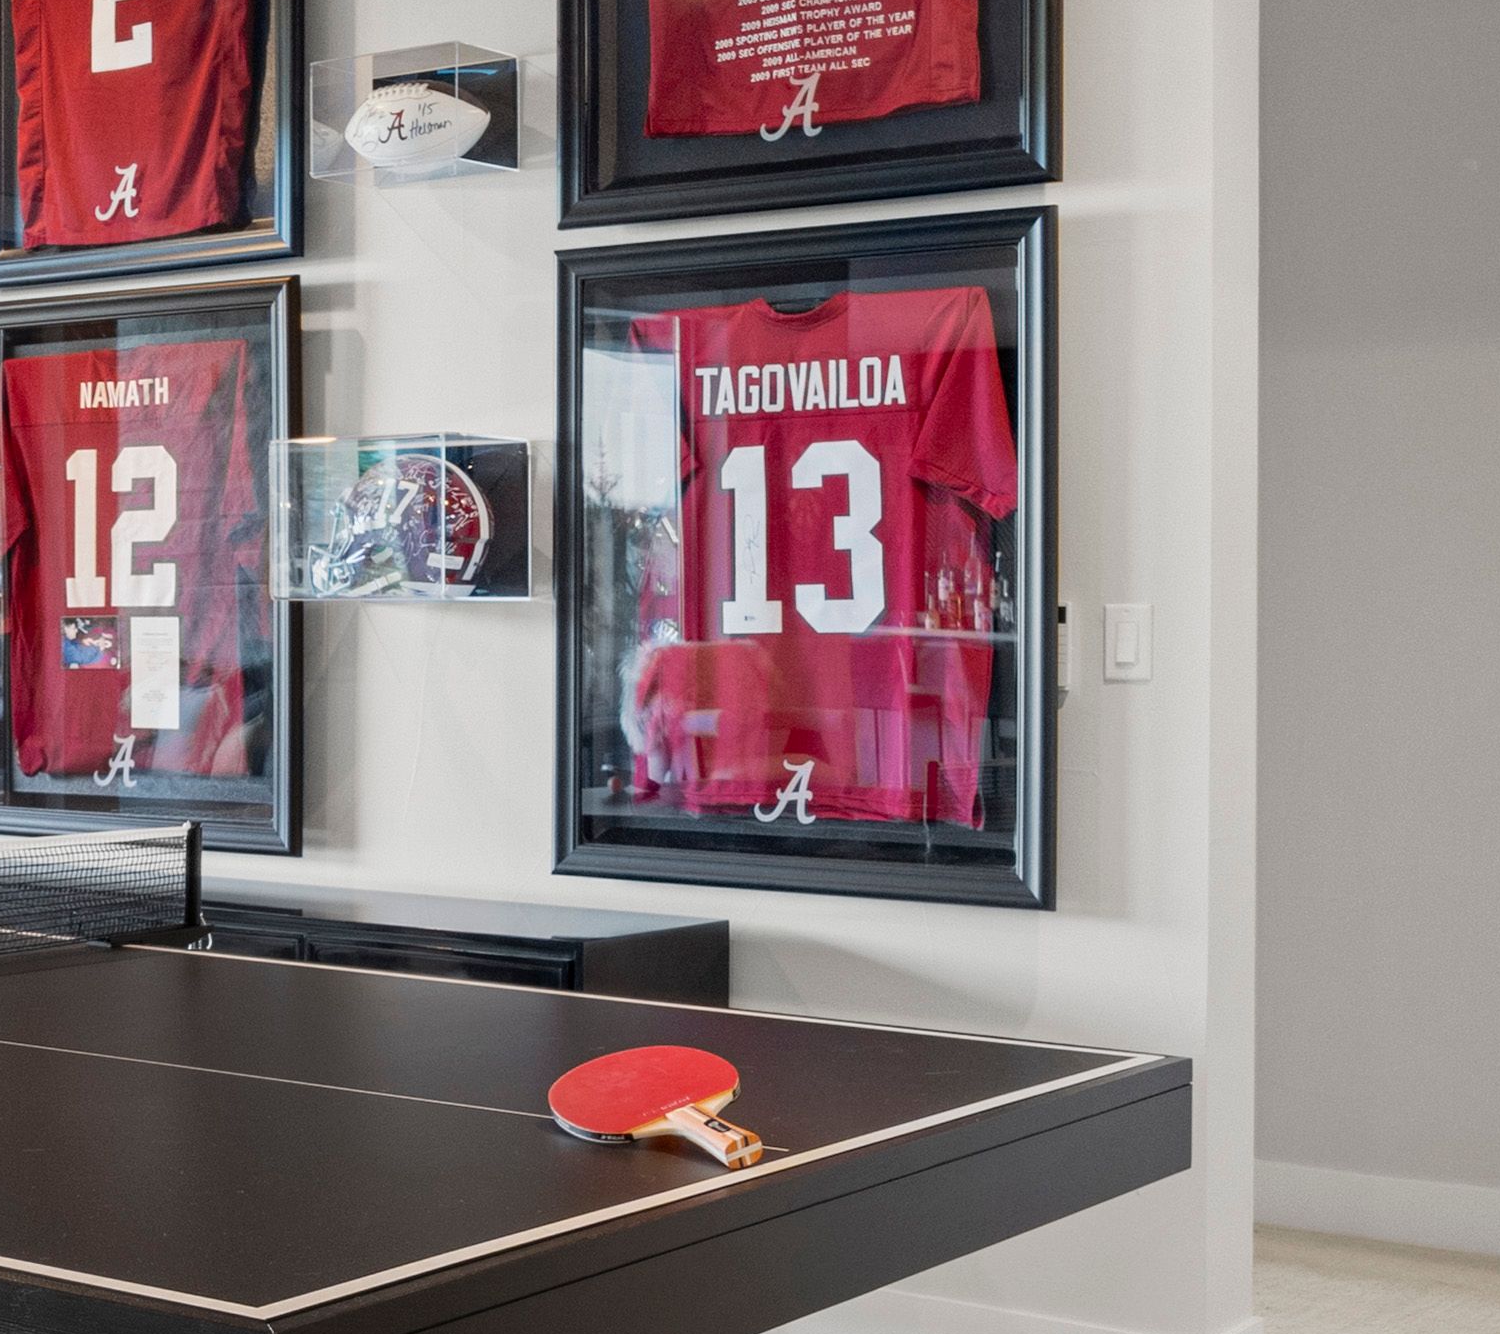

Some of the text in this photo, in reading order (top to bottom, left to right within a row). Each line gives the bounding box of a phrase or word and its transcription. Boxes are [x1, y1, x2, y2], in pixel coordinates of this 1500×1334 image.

[741, 2, 882, 32] 2009 HEISMAN TROPHY AWARD
[761, 3, 779, 15] 2009
[781, 0, 796, 11] SEC
[715, 10, 915, 50] 2009 SPORTING NEWS PLAYER OF THE YEAR
[717, 24, 912, 62] 2009 SEC OFFENSIVE PLAYER OF THE YEAR
[750, 57, 871, 83] 2009 FIRST TEAM ALL SEC
[762, 46, 856, 67] 2009 ALL-AMERICAN
[379, 109, 408, 143] A
[760, 73, 823, 142] A
[95, 163, 138, 222] A
[79, 376, 169, 409] NAMATH
[694, 354, 906, 417] TAGOVAILOA
[65, 445, 178, 608] 12
[721, 440, 887, 635] 13
[93, 733, 138, 788] A
[754, 757, 816, 824] A
